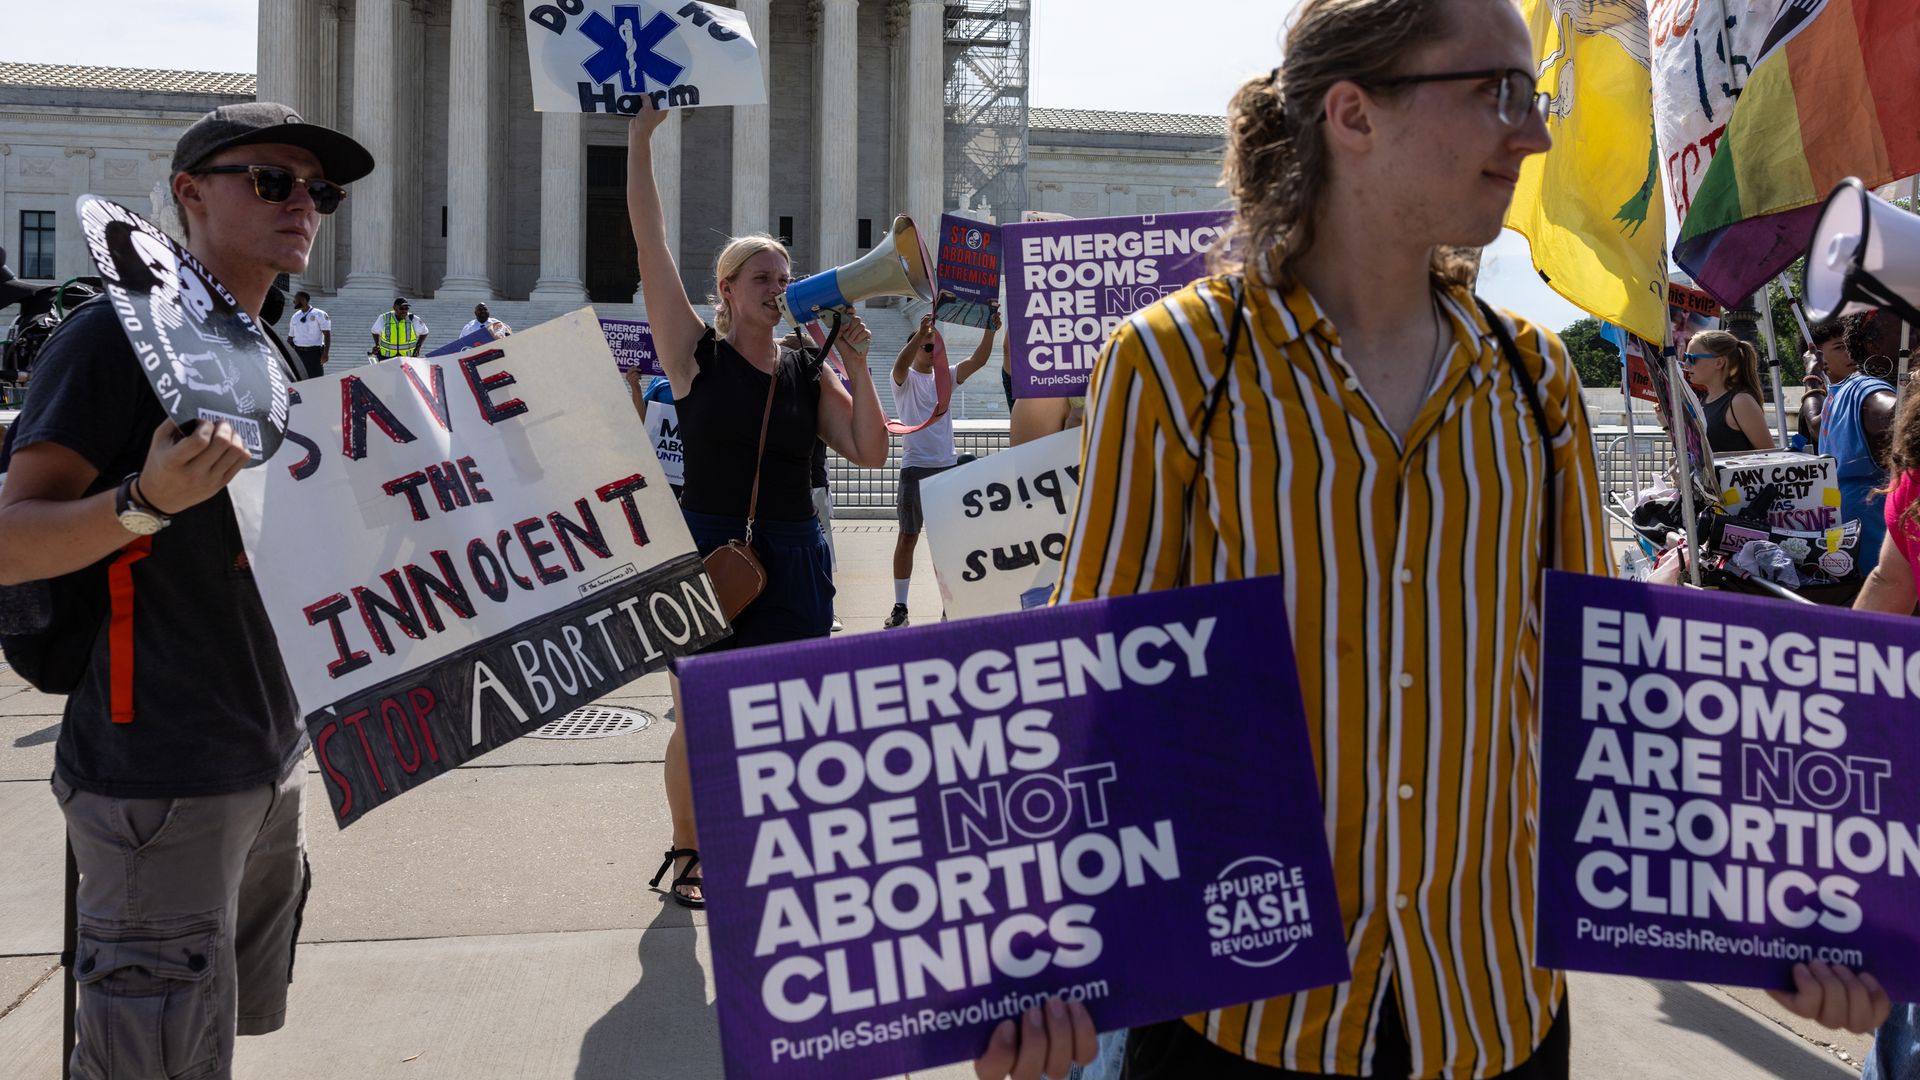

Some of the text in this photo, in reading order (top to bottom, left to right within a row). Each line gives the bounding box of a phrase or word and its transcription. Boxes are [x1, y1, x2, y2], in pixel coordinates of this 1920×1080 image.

[529, 0, 740, 42] Do No
[577, 82, 699, 115] Harm
[181, 247, 237, 307] KILLED
[938, 263, 998, 288] EXTREMISM
[942, 245, 997, 270] ABORTION
[1023, 258, 1159, 290] ROOMS
[108, 283, 143, 332] OUR
[236, 311, 261, 336] BY
[1024, 290, 1096, 318] ARE
[1688, 292, 1716, 312] Evil?
[135, 340, 161, 371] OF
[624, 341, 646, 350] NOT
[156, 372, 182, 415] 1/3
[381, 455, 494, 521] THE
[1730, 463, 1829, 487] AMY CONEY
[302, 473, 648, 679] INNOCENT
[962, 533, 1067, 582] oms
[318, 574, 727, 818] STOP ABORTION
[728, 617, 1217, 749] EMERGENCY
[1581, 665, 1847, 749] ROOMS
[737, 709, 1059, 816] ROOMS
[1575, 727, 1892, 815] ARE NOT
[745, 762, 1117, 886] ARE NOT
[1574, 788, 1920, 878] ABORTION
[754, 819, 1180, 957] ABORTION
[1203, 866, 1305, 905] #PURPLE
[1575, 850, 1863, 934] CLINICS
[1206, 887, 1310, 938] SASH
[761, 904, 1103, 1023] CLINICS
[1210, 922, 1313, 957] REVOLUTION
[1577, 917, 1863, 966] PurpleSashRevolution.com
